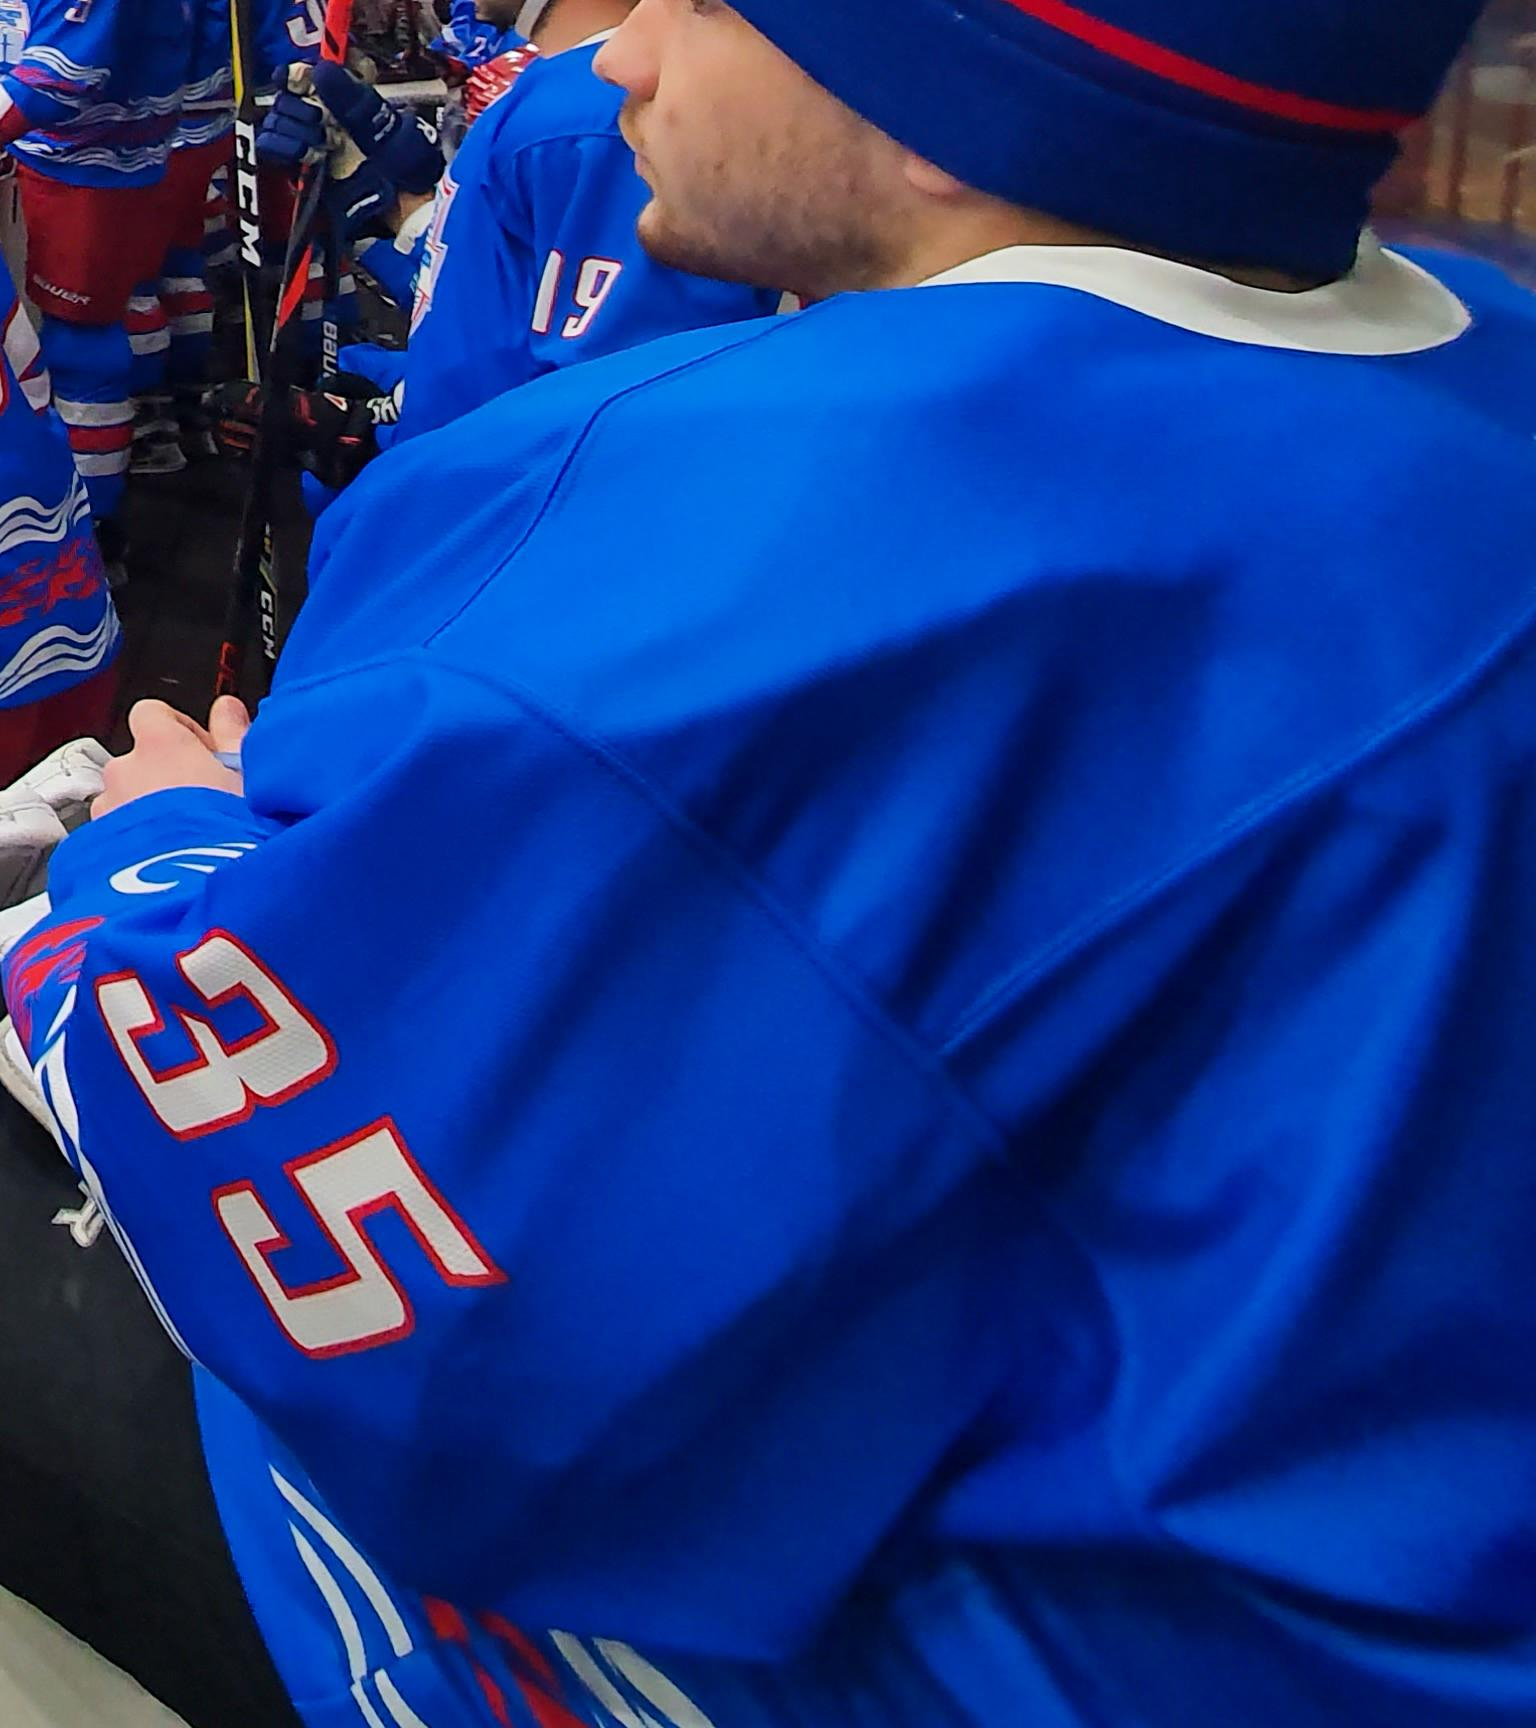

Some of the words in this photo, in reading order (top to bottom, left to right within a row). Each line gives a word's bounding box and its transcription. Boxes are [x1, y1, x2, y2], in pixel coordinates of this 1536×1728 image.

[235, 119, 262, 268] CCM
[530, 248, 623, 338] 19
[323, 320, 338, 378] BAU
[261, 590, 277, 660] CCM
[94, 928, 510, 1360] 35
